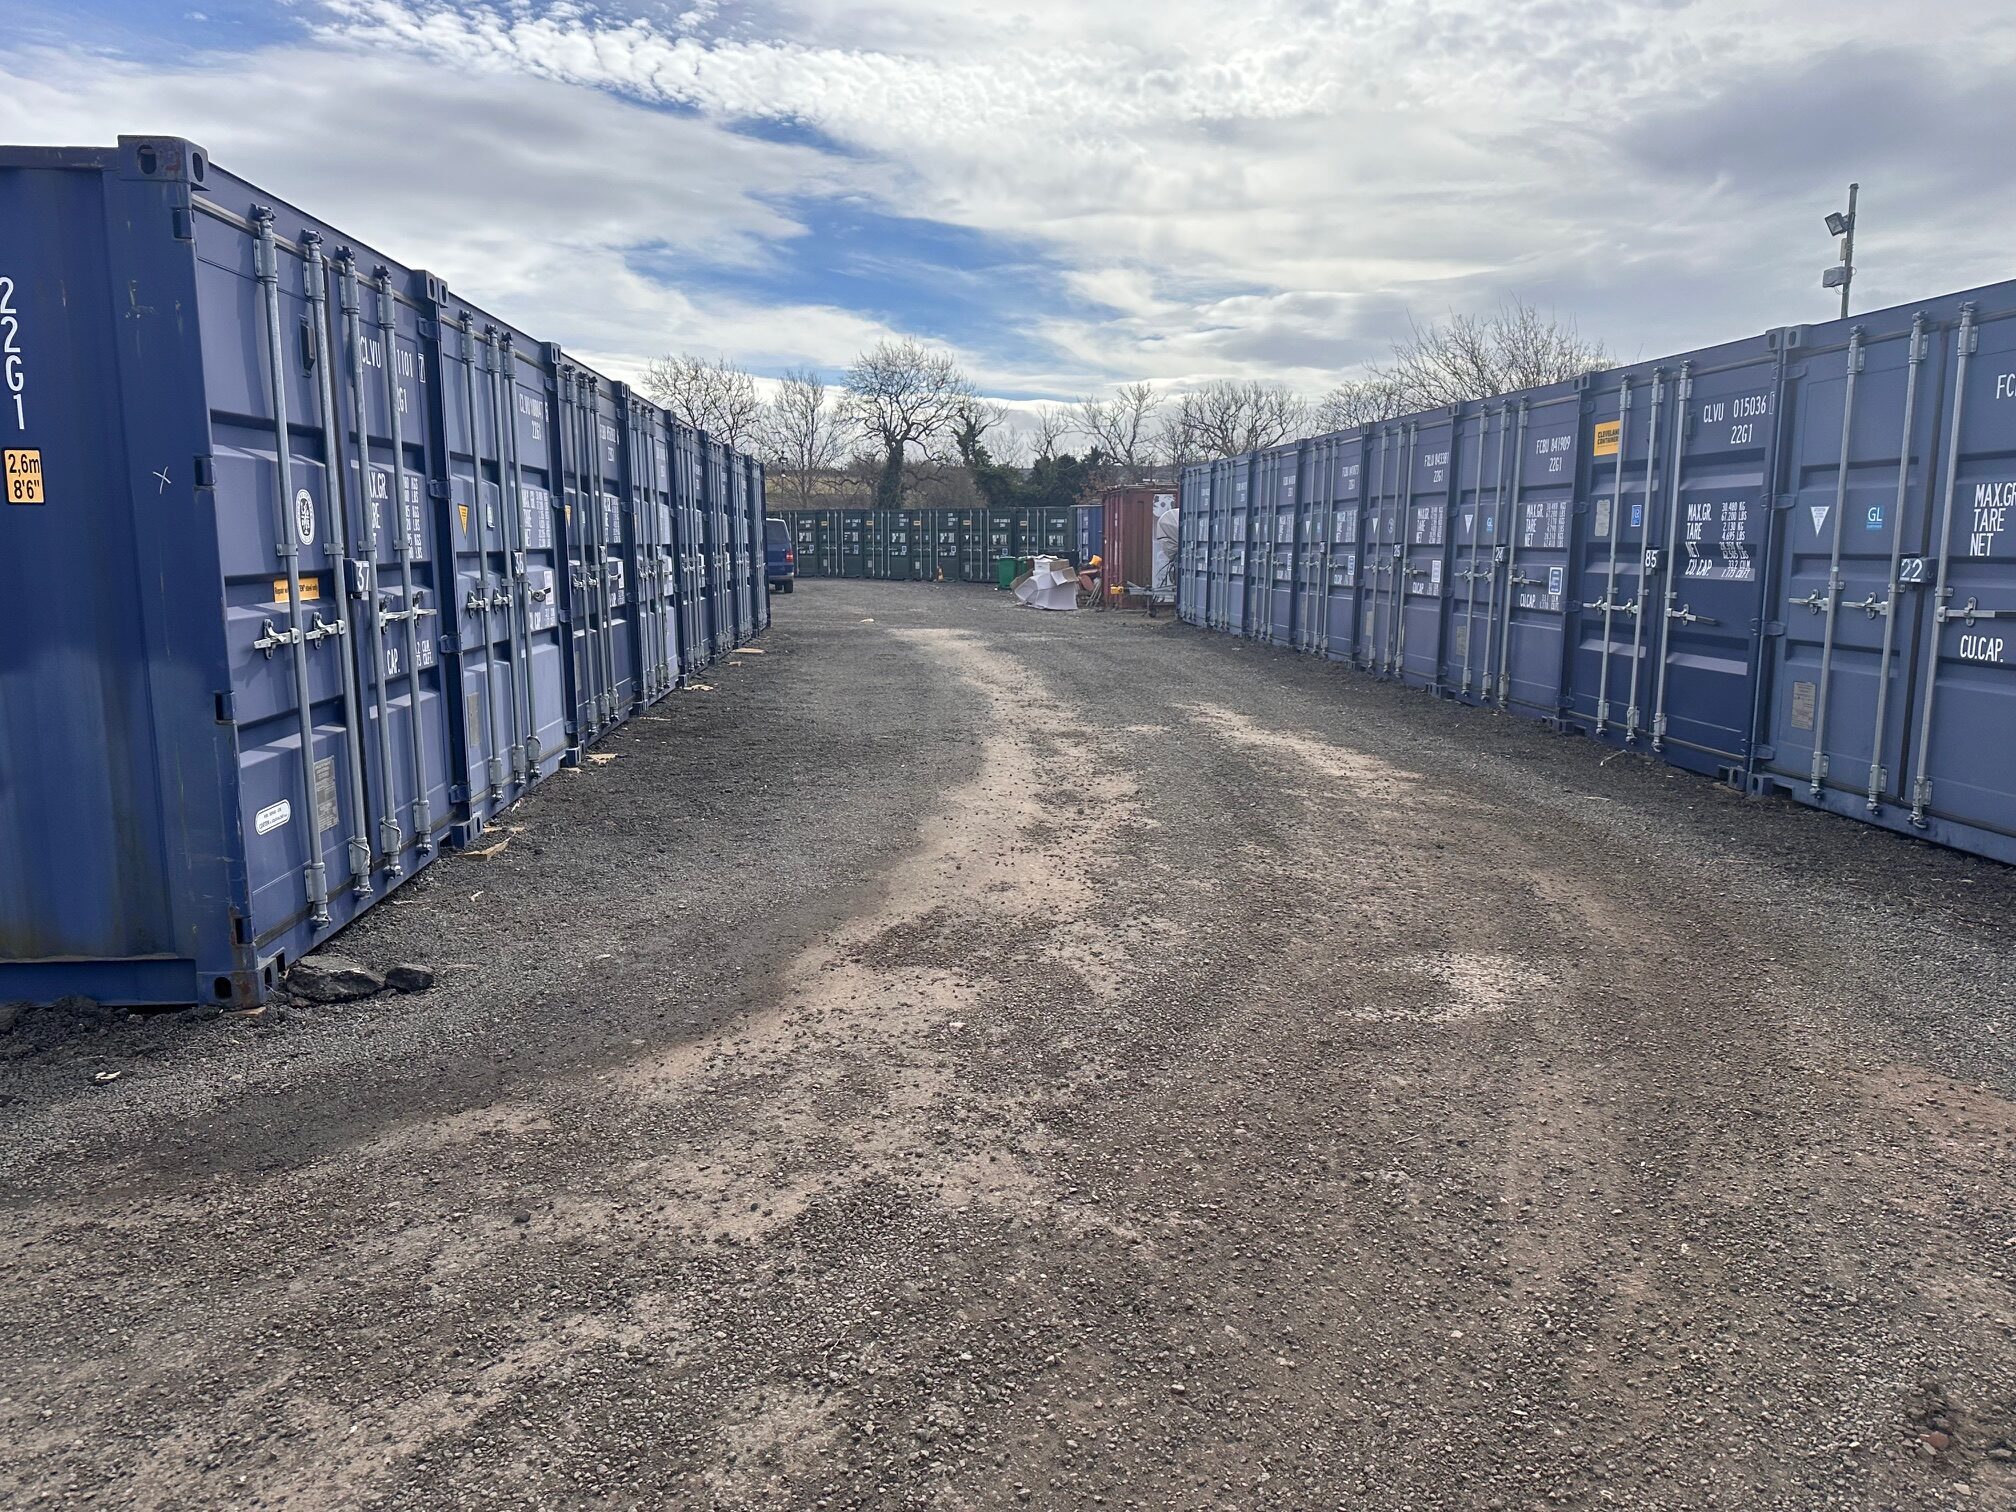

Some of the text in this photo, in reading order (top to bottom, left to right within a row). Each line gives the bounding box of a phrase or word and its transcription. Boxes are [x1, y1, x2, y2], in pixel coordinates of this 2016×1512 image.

[0, 277, 25, 430] 22G1
[360, 335, 381, 369] CLVU
[1996, 373, 2016, 399] FC
[1703, 403, 1725, 423] CLVU
[1733, 395, 1767, 418] 015036
[1730, 423, 1753, 444] 22G1
[8, 454, 40, 477] 2,6m
[1549, 456, 1562, 472] 22G1
[1867, 507, 1883, 521] GL
[1973, 508, 2006, 532] TARE
[1686, 522, 1703, 540] TARE
[1969, 533, 1994, 556] NET
[1645, 550, 1659, 568] 85
[1900, 559, 1923, 582] 22
[355, 561, 370, 591] 37
[1960, 635, 2004, 662] CU.CAP.
